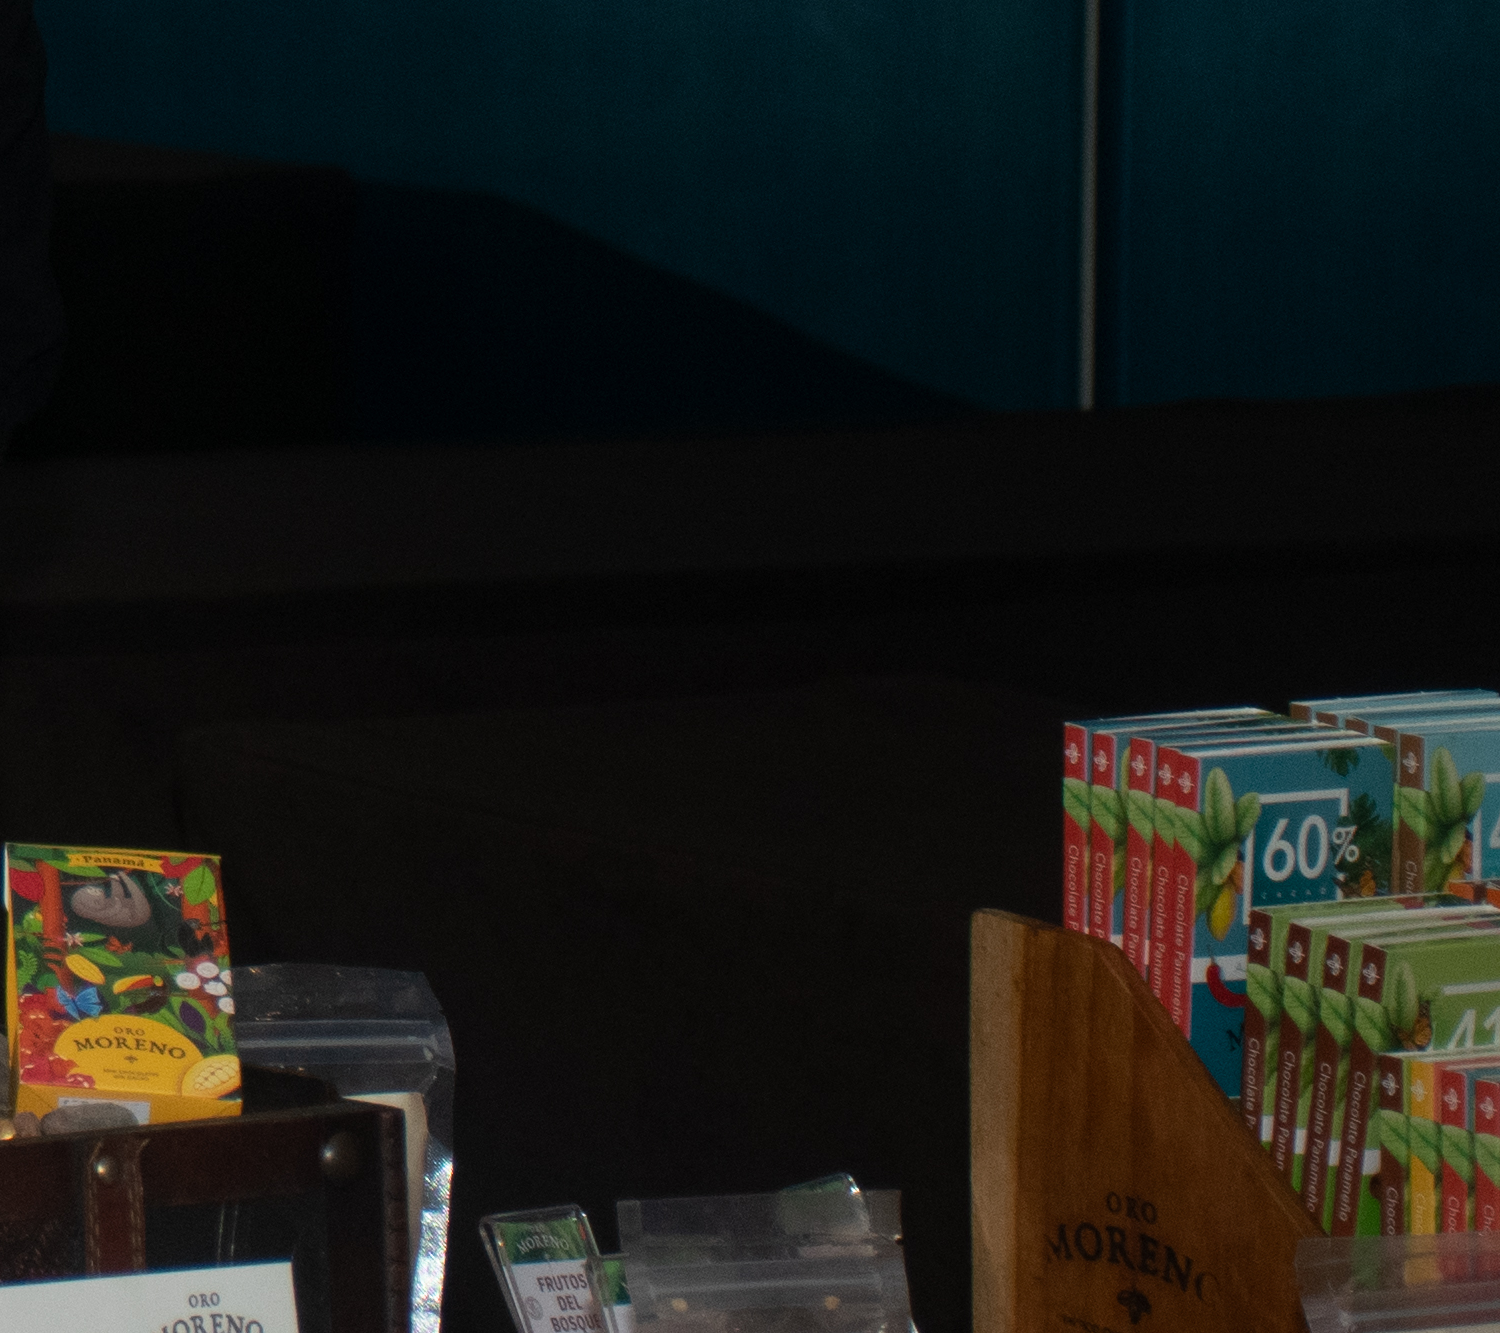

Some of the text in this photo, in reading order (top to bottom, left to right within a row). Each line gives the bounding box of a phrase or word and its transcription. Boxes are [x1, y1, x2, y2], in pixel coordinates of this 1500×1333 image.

[83, 853, 145, 868] Panamá
[1068, 844, 1079, 917] Chocolate
[1262, 814, 1360, 884] 60%
[1093, 852, 1106, 927] Chocolate
[1129, 857, 1143, 929] Chocolate
[1155, 865, 1169, 939] Chocolate
[1175, 875, 1188, 947] Chocolate
[73, 1035, 187, 1060] MORENO
[113, 1026, 145, 1037] ORO
[1246, 1038, 1260, 1113] Chocolate
[1277, 1050, 1296, 1124] Chocolate
[1313, 1062, 1332, 1136] Chocolate
[1338, 1071, 1366, 1222] Chocolate Panameño
[1106, 1191, 1158, 1224] ORO
[516, 1235, 569, 1254] MORENO
[189, 1292, 220, 1308] ORO
[536, 1273, 588, 1293] FRUTOS
[556, 1294, 583, 1311] DEL
[550, 1313, 601, 1333] BOSQUE
